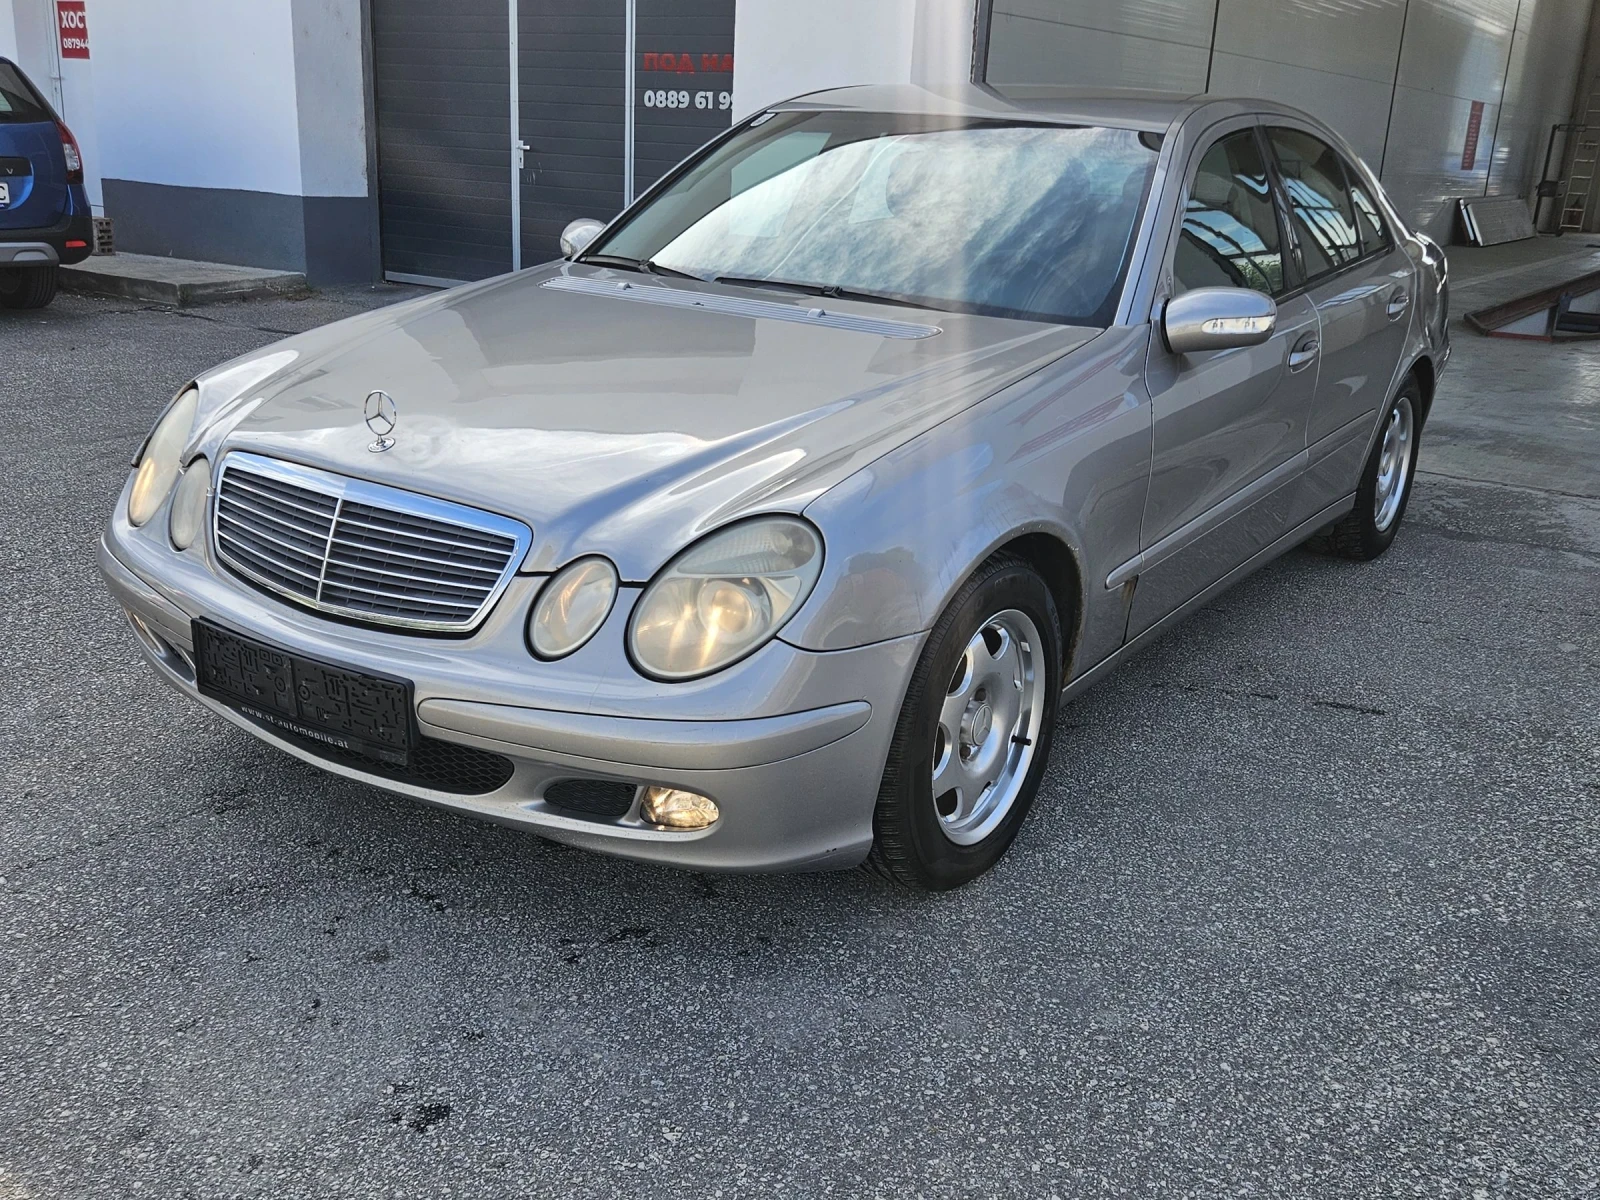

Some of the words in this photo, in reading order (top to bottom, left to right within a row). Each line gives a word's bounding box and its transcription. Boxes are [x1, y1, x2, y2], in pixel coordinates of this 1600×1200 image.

[643, 53, 695, 74] ПОД
[644, 90, 690, 108] 0889
[695, 91, 713, 109] 61
[718, 91, 733, 110] 9
